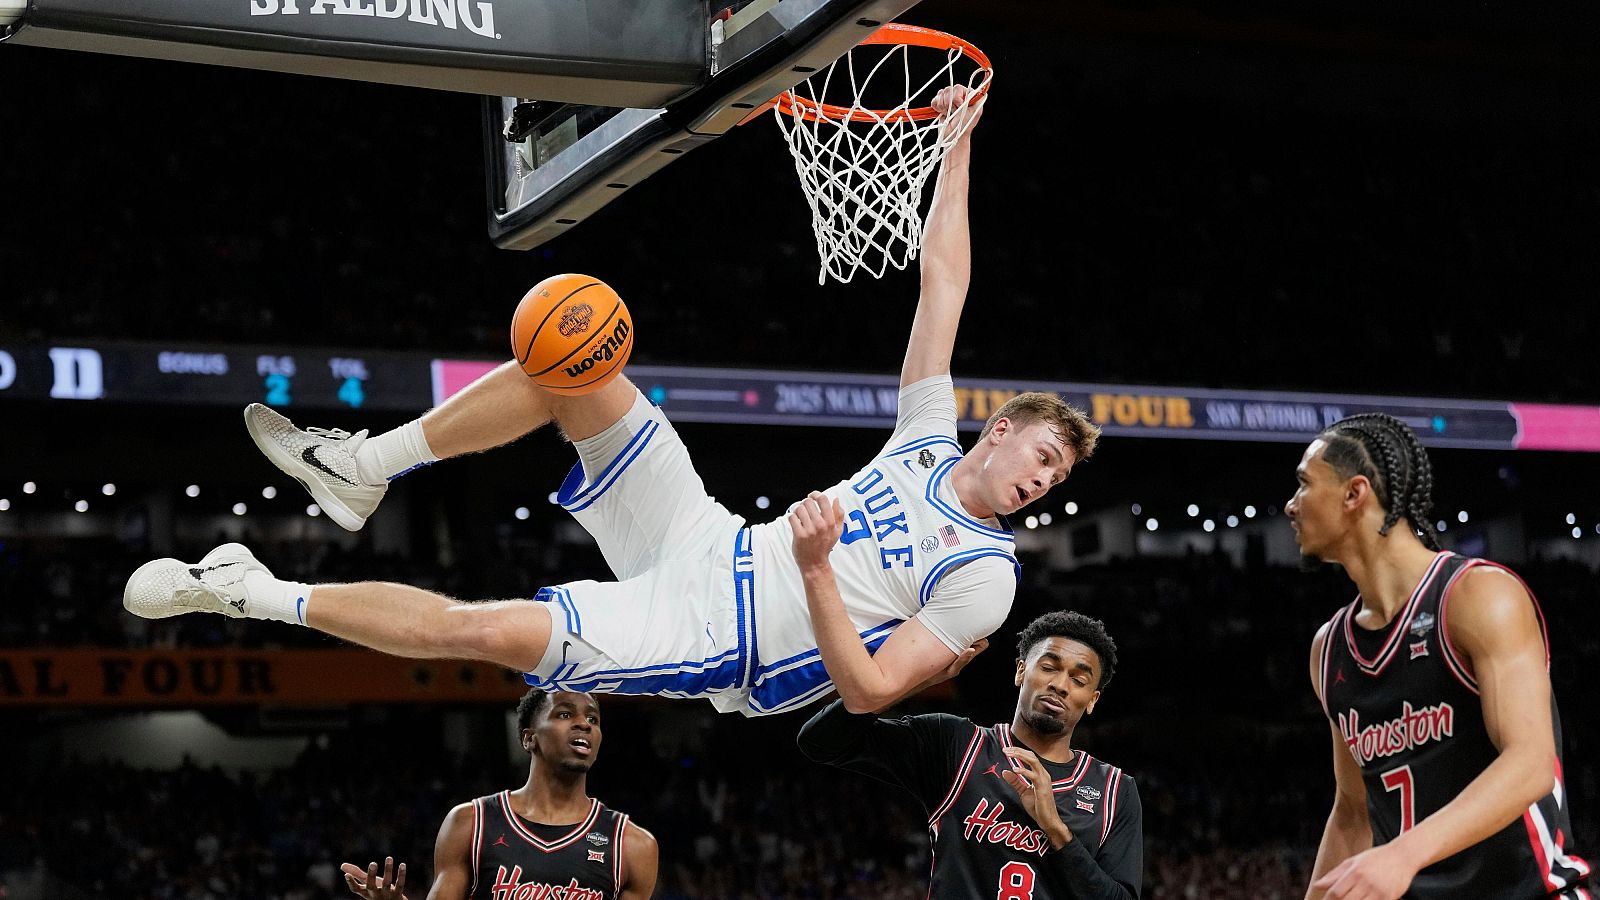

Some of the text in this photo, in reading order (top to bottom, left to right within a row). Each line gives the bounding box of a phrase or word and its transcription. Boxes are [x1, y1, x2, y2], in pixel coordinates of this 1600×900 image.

[158, 352, 228, 375] BONUS
[563, 318, 629, 378] Wilson
[265, 374, 291, 406] 2
[1091, 393, 1194, 428] FOUR
[852, 468, 914, 569] DUKE
[101, 657, 276, 695] FOUR
[1338, 701, 1454, 767] Houston
[1380, 764, 1415, 835] 7
[964, 797, 1049, 857] Hous
[997, 860, 1035, 900] 8
